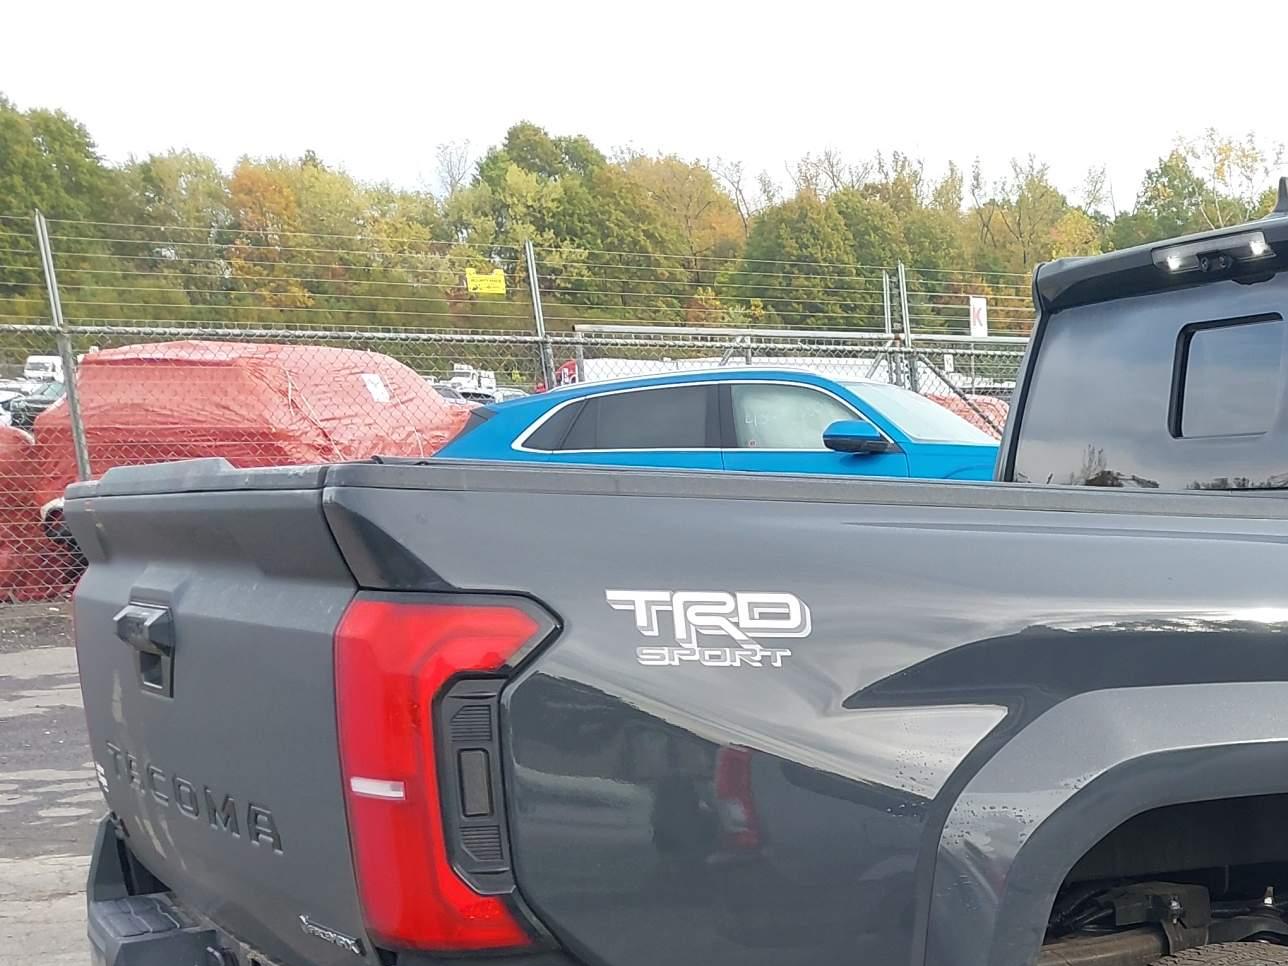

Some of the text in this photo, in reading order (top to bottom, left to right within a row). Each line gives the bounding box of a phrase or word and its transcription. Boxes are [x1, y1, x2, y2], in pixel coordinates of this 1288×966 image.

[605, 589, 812, 648] TRD
[636, 647, 792, 667] SPORT
[106, 741, 284, 855] TACOMA
